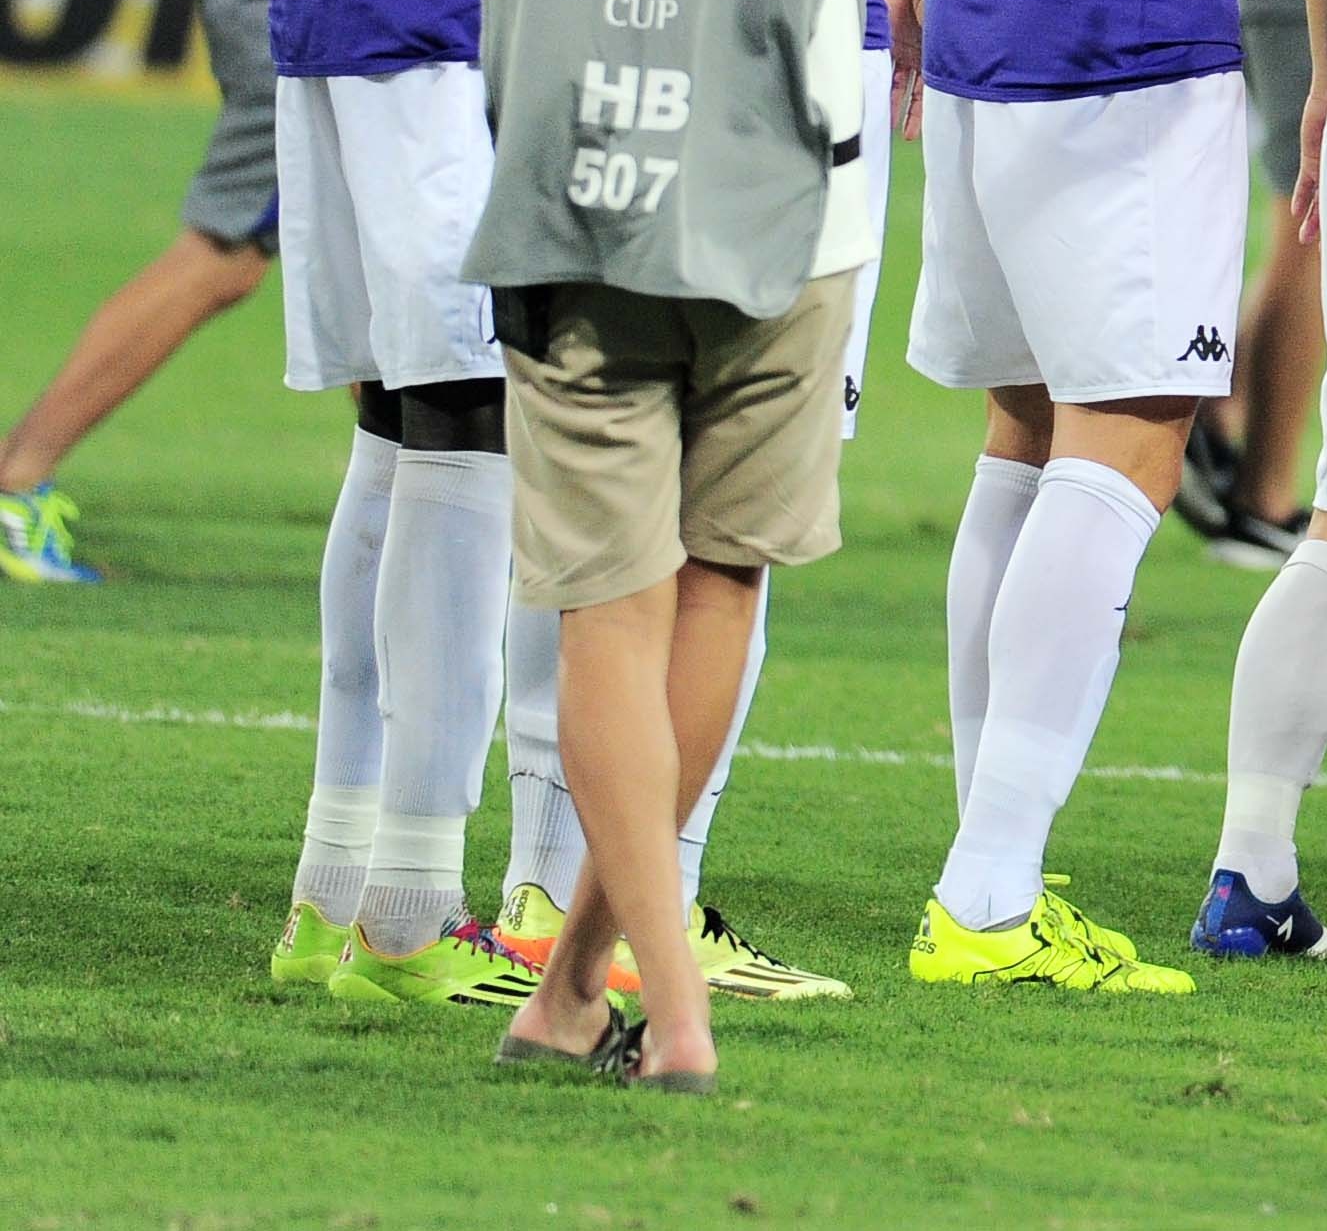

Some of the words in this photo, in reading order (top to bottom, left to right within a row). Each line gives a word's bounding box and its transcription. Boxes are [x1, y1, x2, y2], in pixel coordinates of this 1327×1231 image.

[578, 61, 690, 132] HB
[567, 149, 681, 211] 507
[513, 888, 529, 931] adidas
